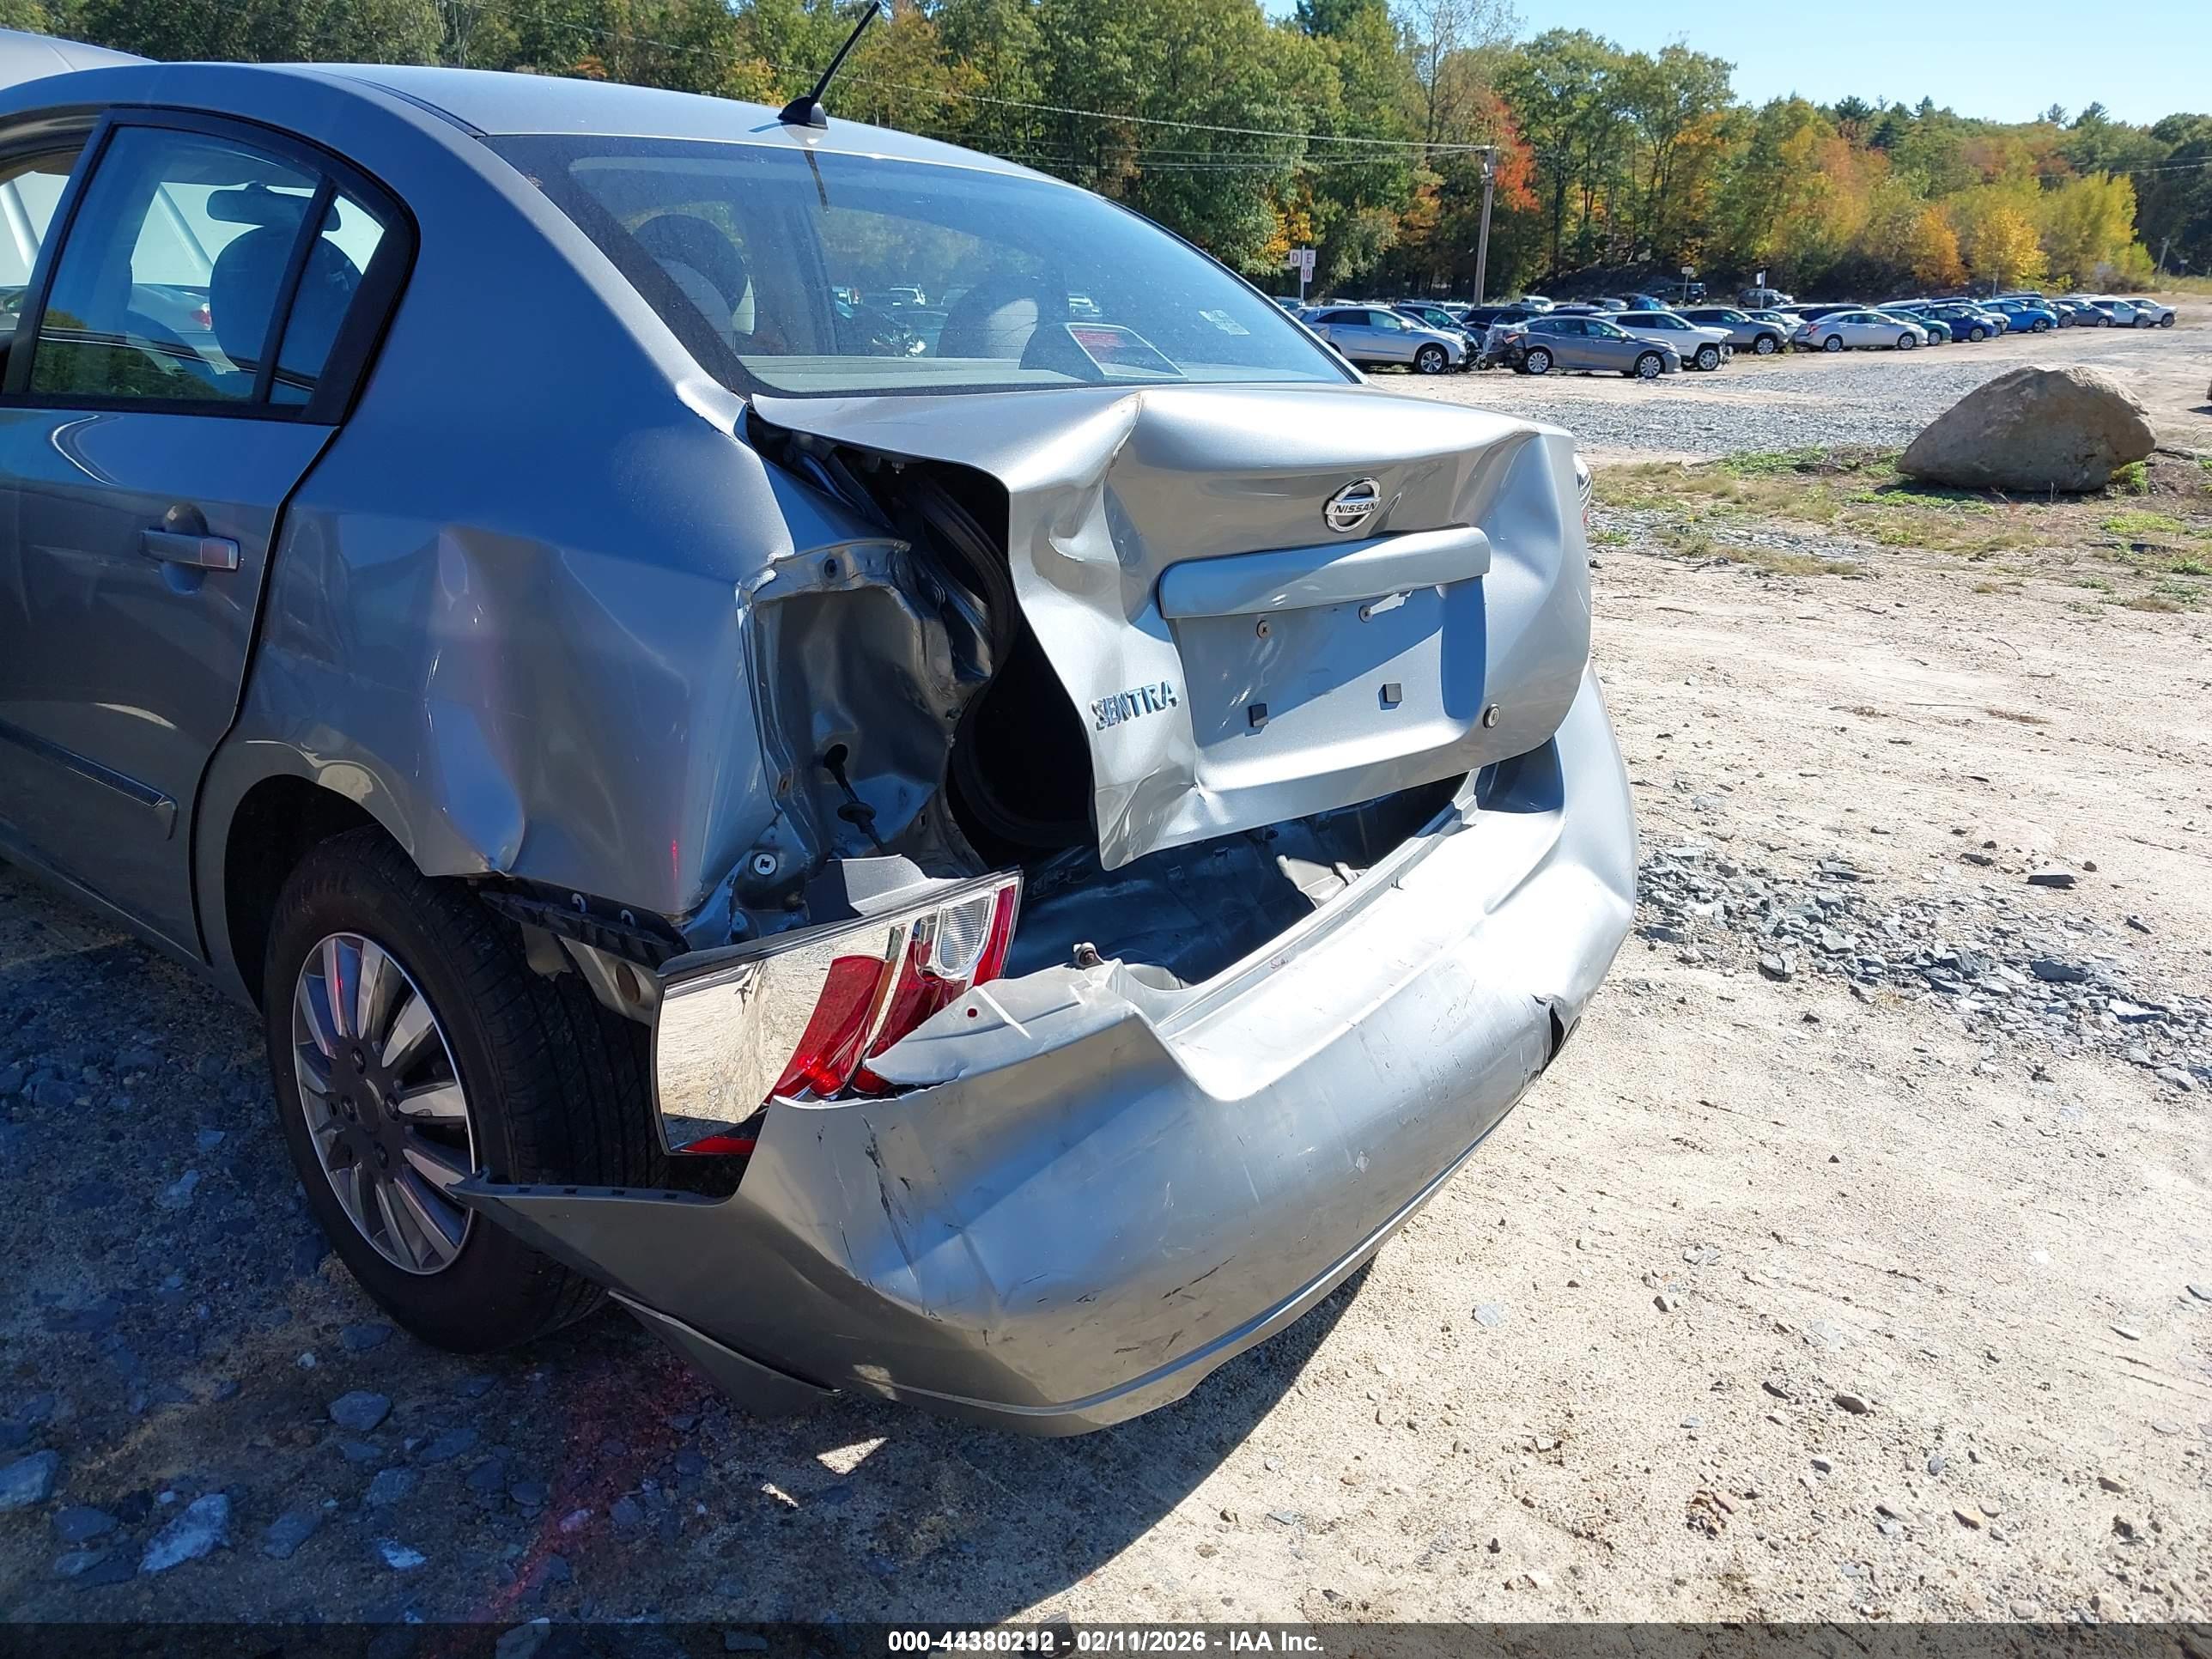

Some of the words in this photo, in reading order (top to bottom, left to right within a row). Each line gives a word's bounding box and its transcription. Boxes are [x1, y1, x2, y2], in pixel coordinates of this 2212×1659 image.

[1291, 252, 1299, 264] D
[1306, 253, 1312, 264] E
[1302, 269, 1311, 279] 10
[1334, 502, 1376, 514] NISSAN
[1091, 680, 1180, 730] SENTRA
